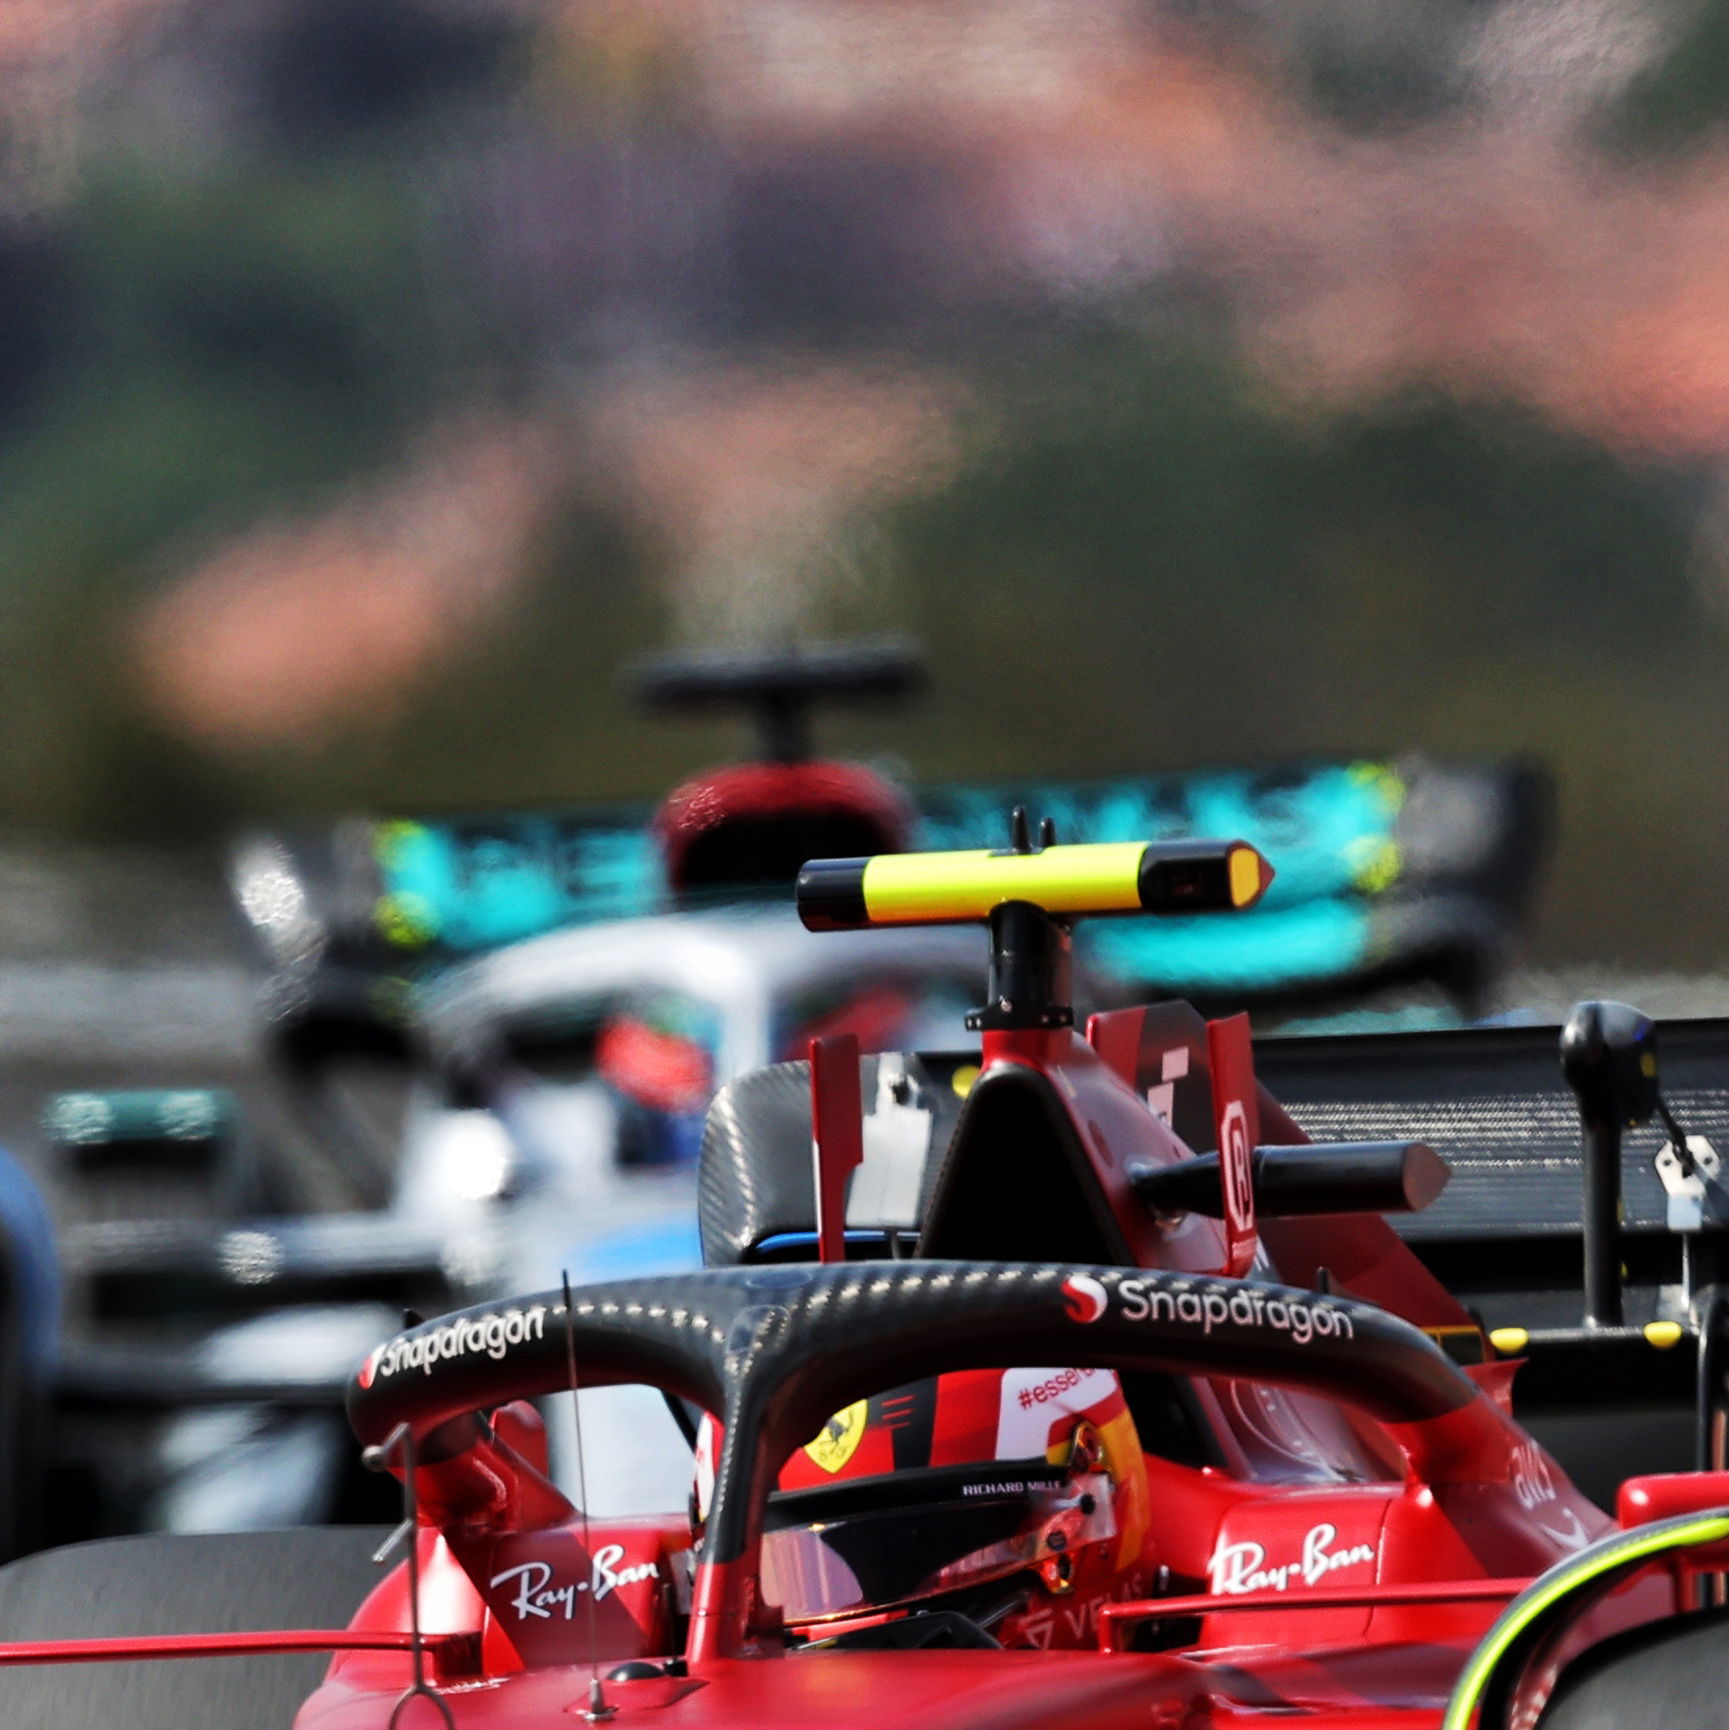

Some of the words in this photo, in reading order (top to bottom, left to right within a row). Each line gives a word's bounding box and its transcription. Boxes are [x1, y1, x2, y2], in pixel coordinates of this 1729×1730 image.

[380, 1307, 546, 1376] Snapdragon
[1119, 1279, 1355, 1345] Snapdragon
[962, 1482, 1025, 1496] RICHARD
[1027, 1480, 1062, 1492] MILLE
[490, 1544, 660, 1620] Ray-Ban
[1208, 1522, 1375, 1596] Ray-Ban
